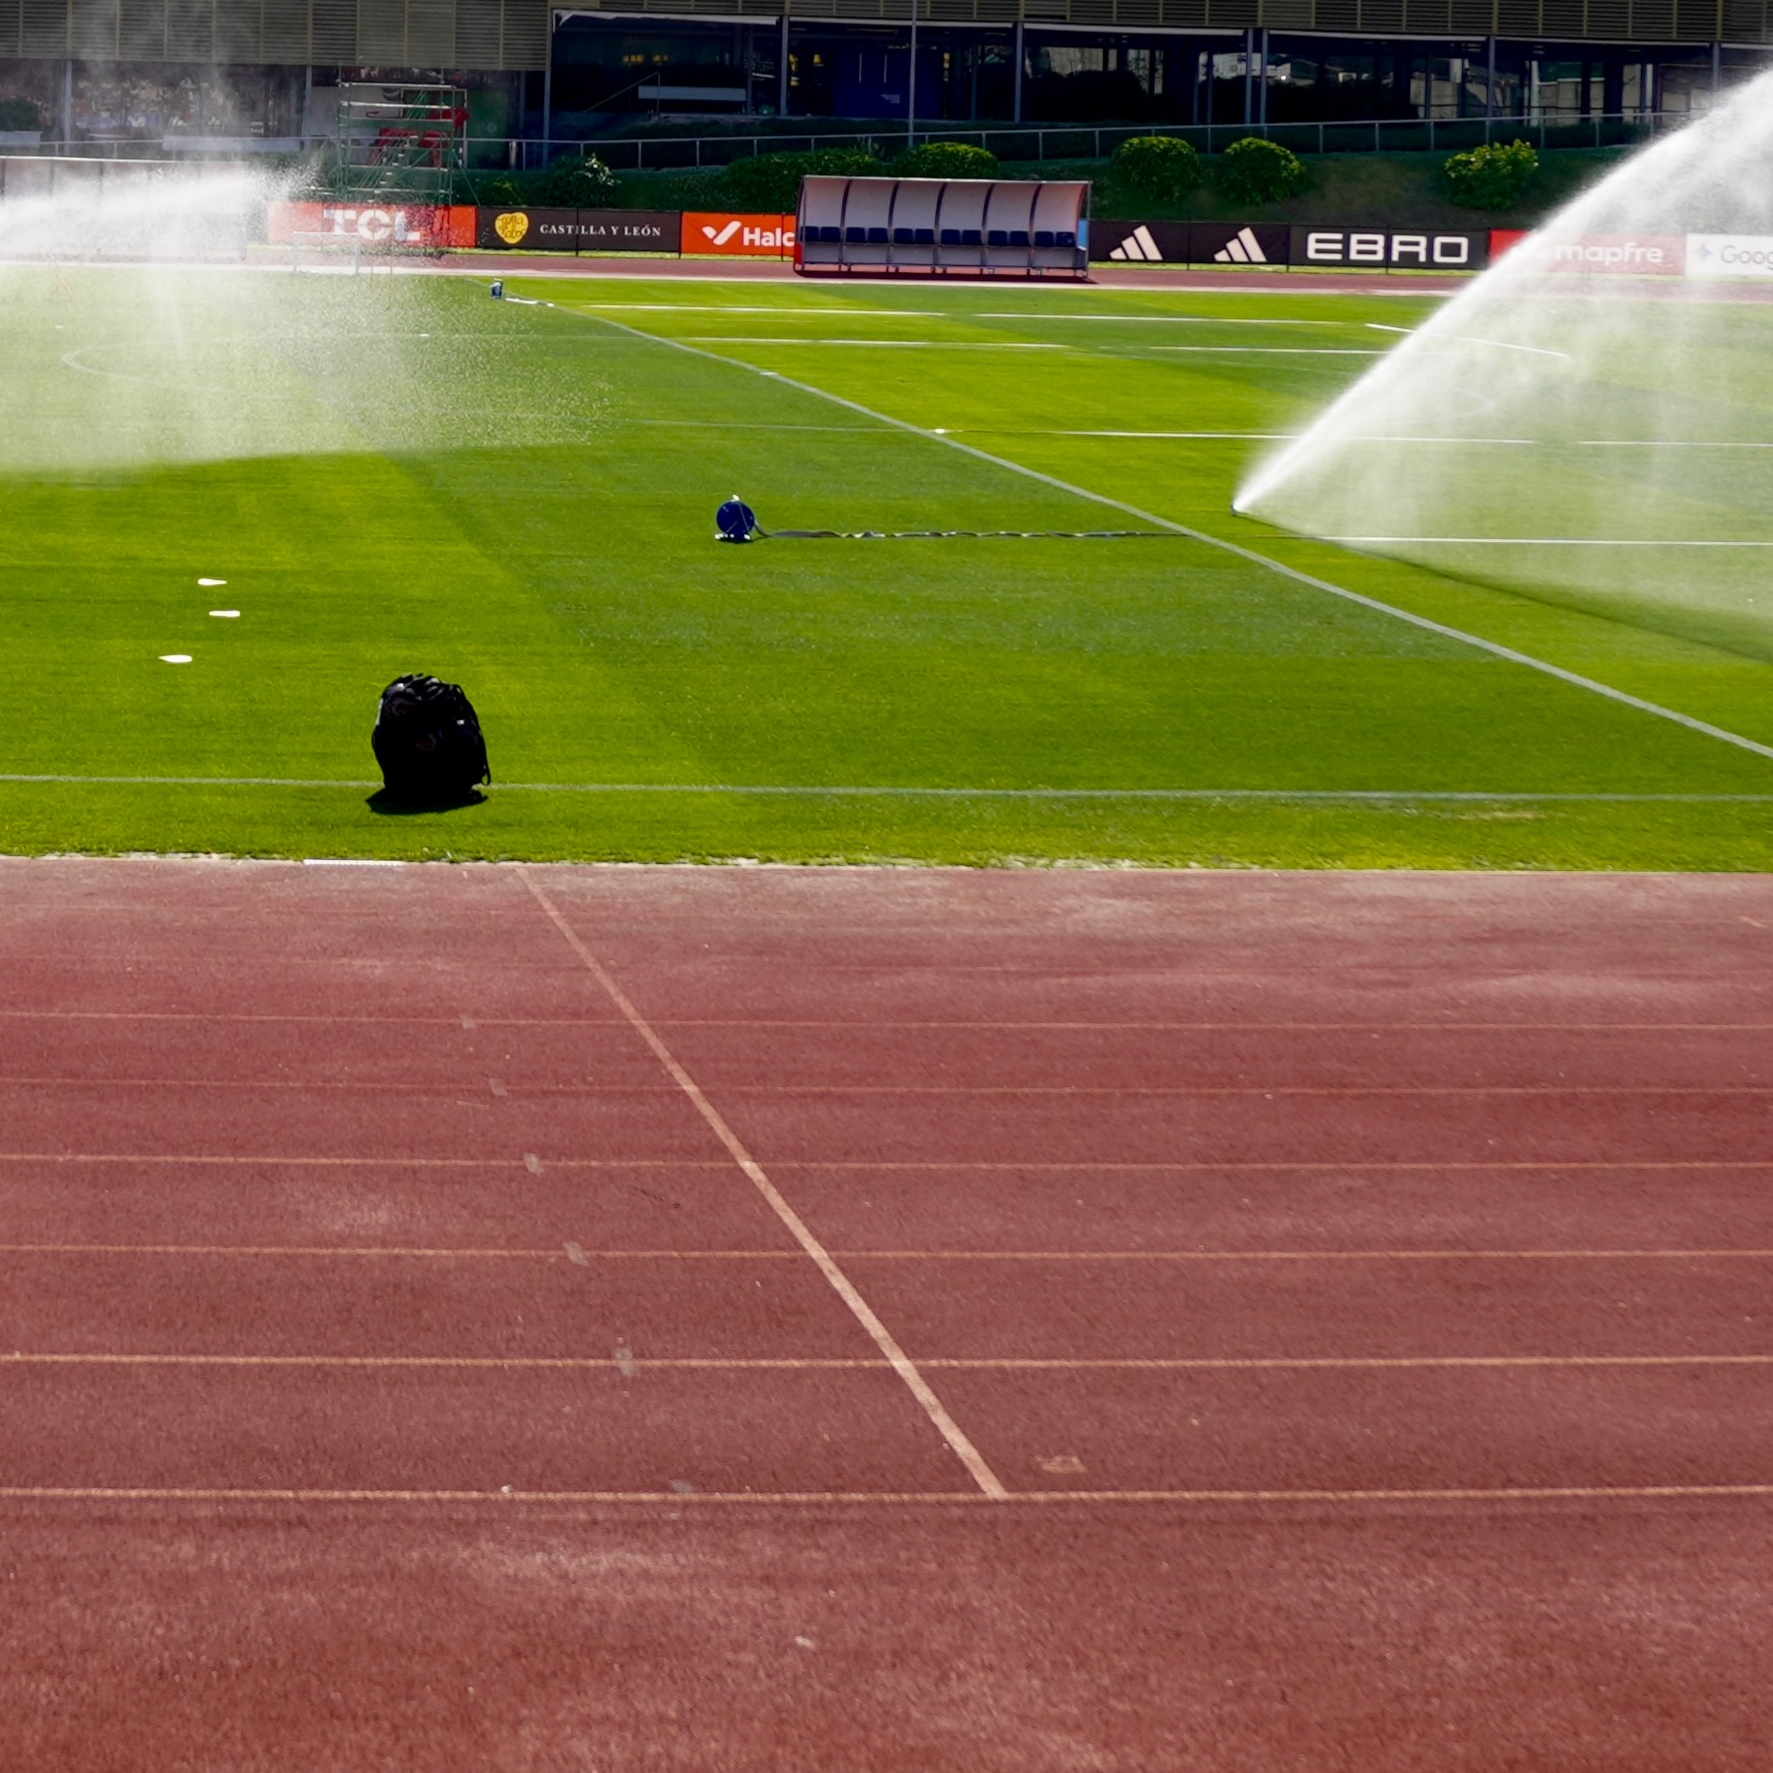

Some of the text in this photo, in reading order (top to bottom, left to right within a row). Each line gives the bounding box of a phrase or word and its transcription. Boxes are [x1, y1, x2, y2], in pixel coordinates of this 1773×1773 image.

[323, 209, 420, 241] TCL
[539, 224, 606, 235] CASTILLA
[611, 226, 619, 236] Y
[624, 224, 661, 236] LEÓN
[1307, 232, 1469, 264] EBRO
[1554, 241, 1664, 266] mapfre
